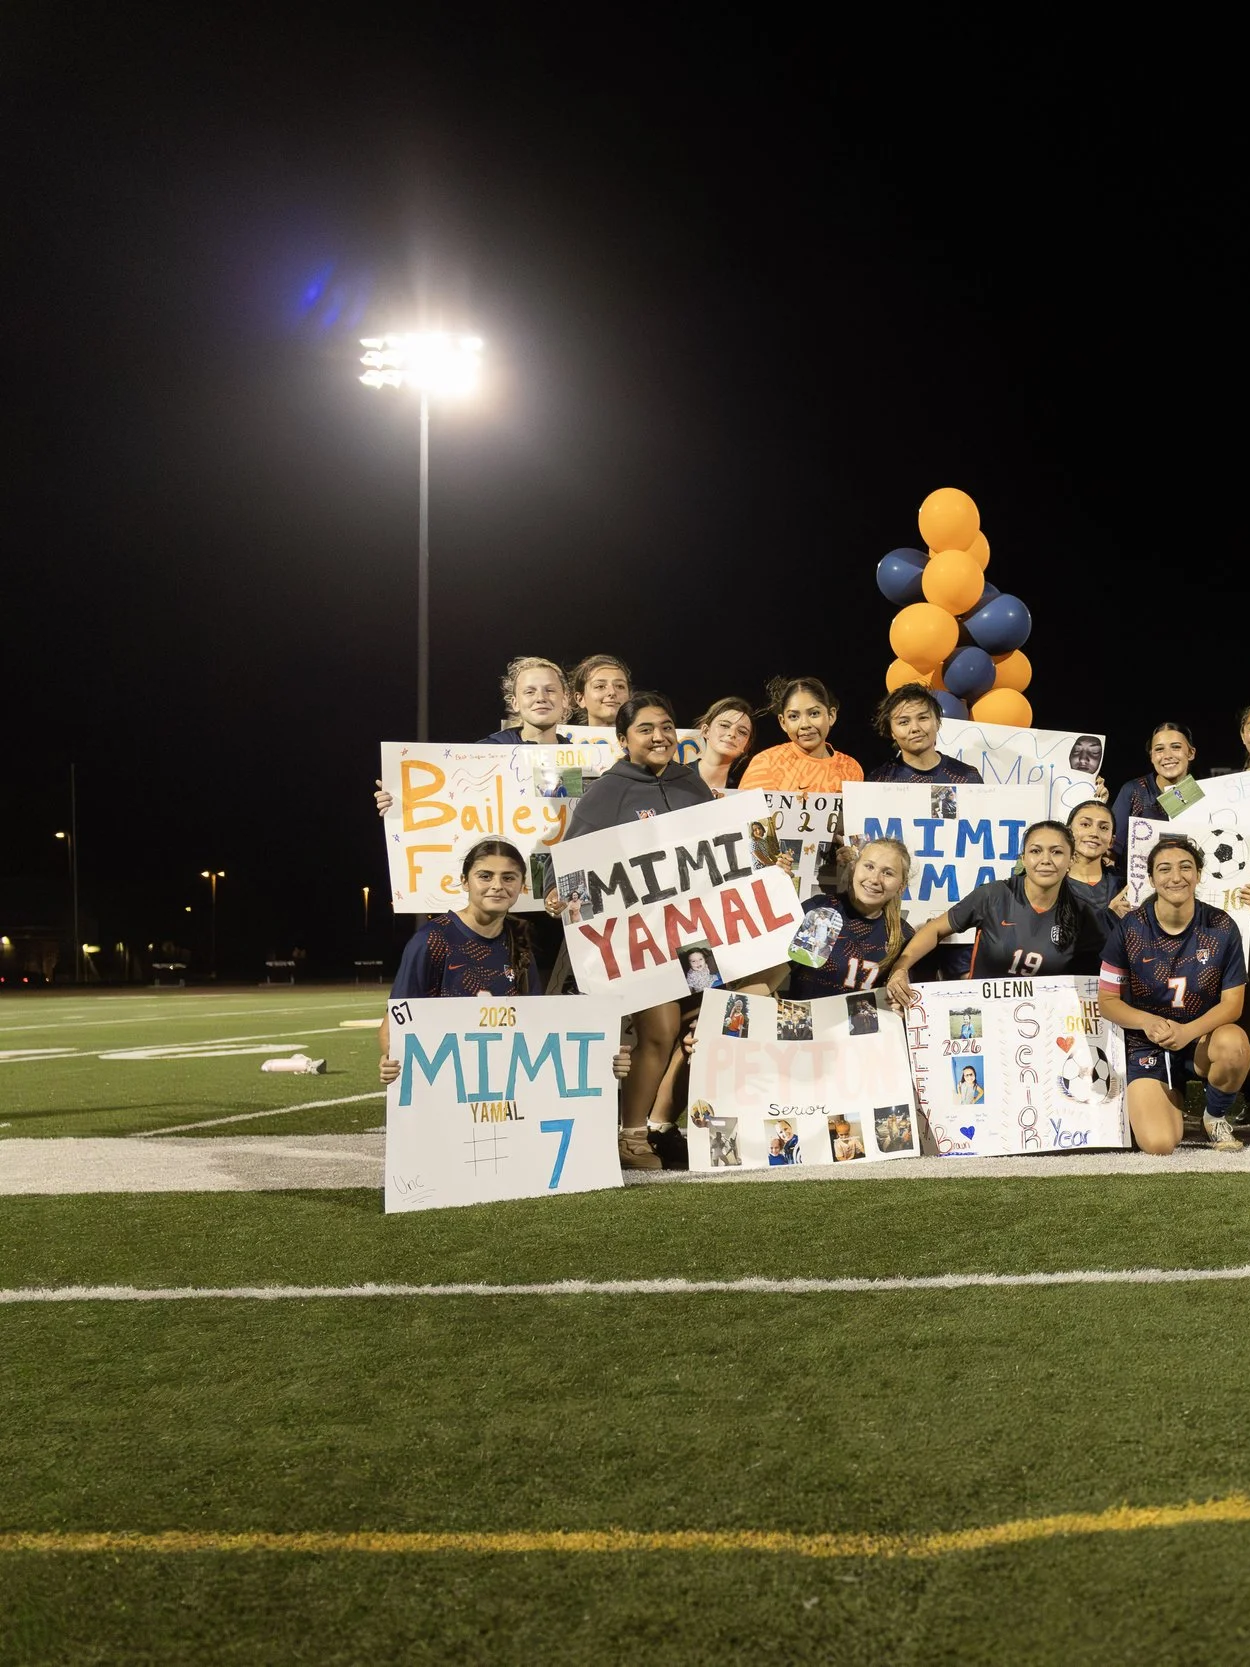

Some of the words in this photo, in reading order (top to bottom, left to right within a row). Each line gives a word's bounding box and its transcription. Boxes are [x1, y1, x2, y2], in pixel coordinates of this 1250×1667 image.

[400, 759, 567, 846] Bailey
[764, 793, 843, 812] ENIOR
[771, 811, 838, 833] 026
[863, 817, 1028, 861] MIMI
[587, 831, 753, 915] MIMI
[578, 878, 795, 981] YAMAL
[843, 957, 880, 990] 17
[1007, 949, 1044, 977] 19
[982, 979, 1034, 999] GLENN
[1167, 976, 1187, 1009] 7
[390, 1000, 414, 1026] 67
[478, 1005, 517, 1028] 2026
[1065, 1015, 1100, 1035] GOAT
[941, 1039, 982, 1056] 2026
[398, 1031, 606, 1107] MIMI
[470, 1099, 525, 1124] YAMAL
[767, 1102, 832, 1116] Senior
[1050, 1117, 1092, 1148] Year
